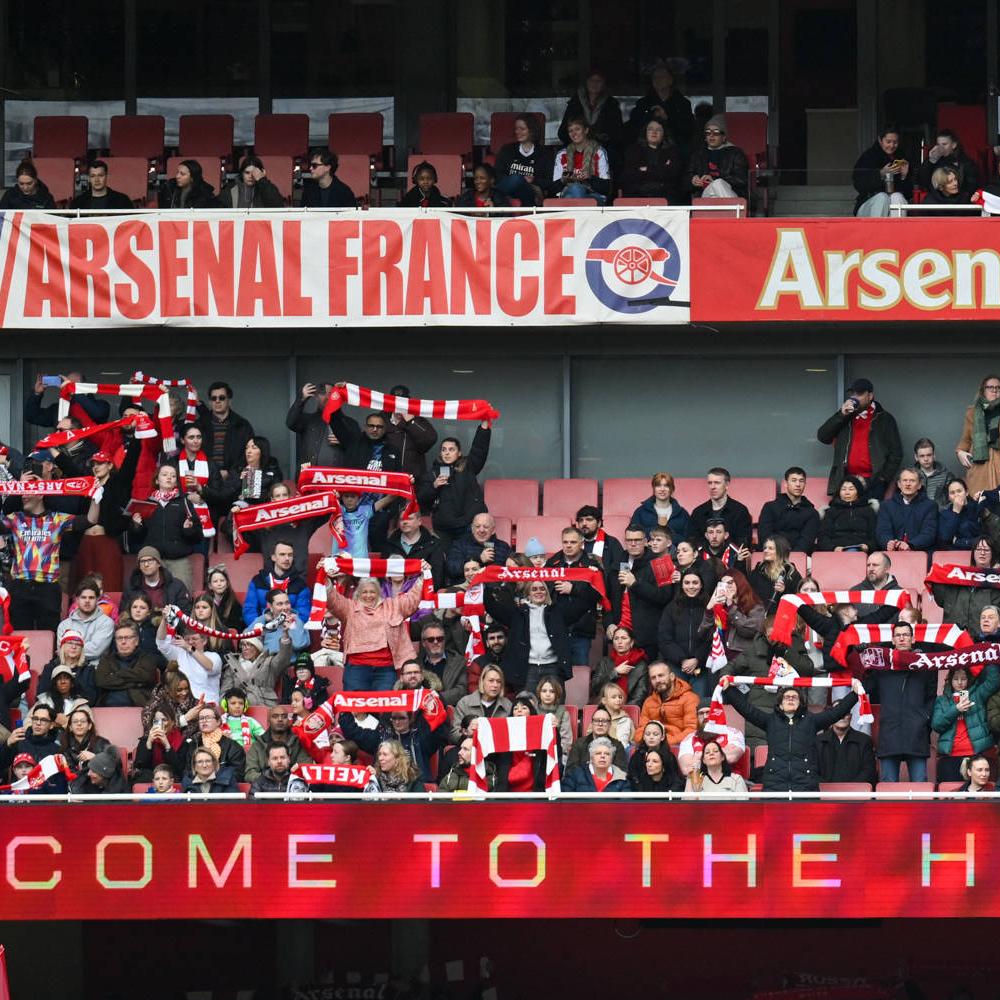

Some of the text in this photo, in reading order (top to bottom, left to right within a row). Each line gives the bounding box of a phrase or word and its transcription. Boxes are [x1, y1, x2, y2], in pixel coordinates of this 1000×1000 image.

[23, 219, 577, 319] ARSENAL FRANCE
[312, 471, 388, 488] Arsenal
[254, 495, 329, 523] Arsenal
[497, 566, 566, 580] Arsenal
[333, 692, 408, 708] Arsenal
[300, 766, 367, 785] KELLY
[6, 833, 338, 890] COME
[413, 833, 546, 888] TO
[625, 833, 842, 888] THE
